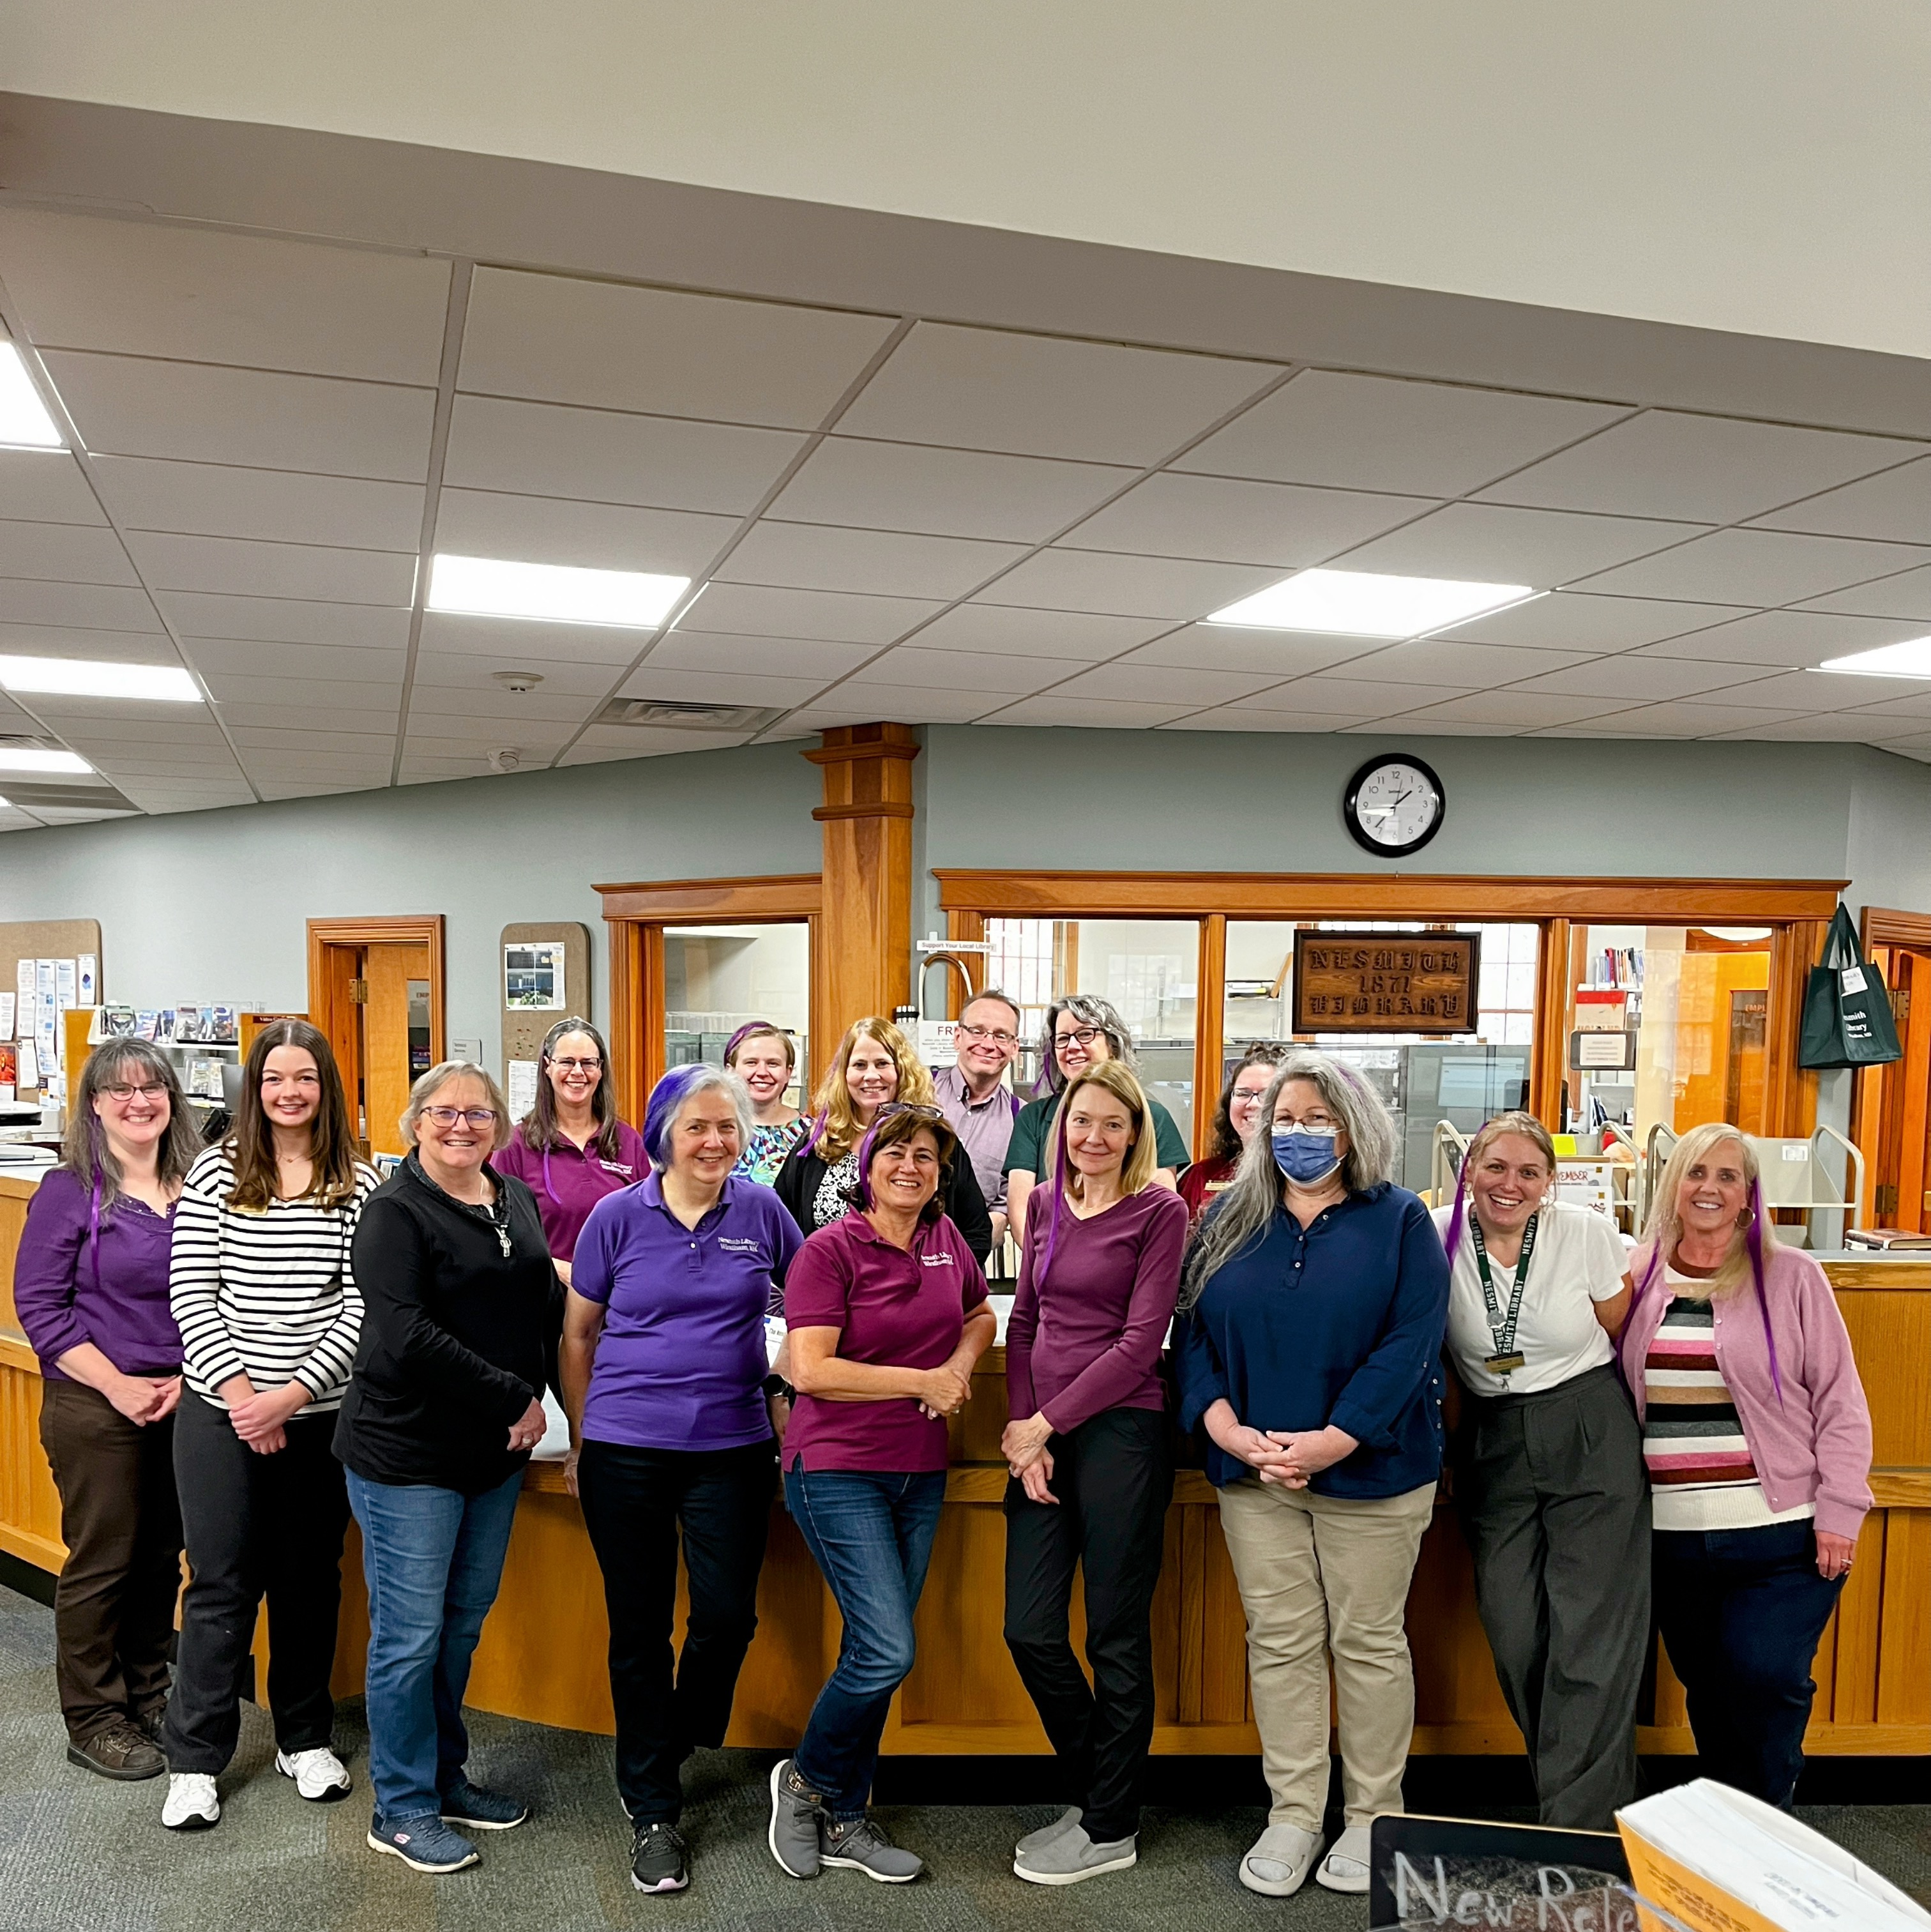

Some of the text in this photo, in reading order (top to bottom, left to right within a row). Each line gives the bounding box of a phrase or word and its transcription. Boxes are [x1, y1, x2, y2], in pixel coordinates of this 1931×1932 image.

[1377, 776, 1384, 784] 11
[1392, 771, 1400, 779] 12
[1418, 785, 1423, 793] 2
[1311, 949, 1460, 973] NESMITH
[1361, 975, 1411, 993] 1871
[1311, 994, 1460, 1018] LIBRARY
[938, 1026, 953, 1035] FR
[1522, 1218, 1536, 1255] NESMITH
[1483, 1281, 1498, 1311] NESMI
[1508, 1279, 1524, 1318] LIBRARY
[1503, 1320, 1515, 1353] ESMITH
[1394, 1852, 1517, 1928] New
[1538, 1867, 1637, 1932] Rele
